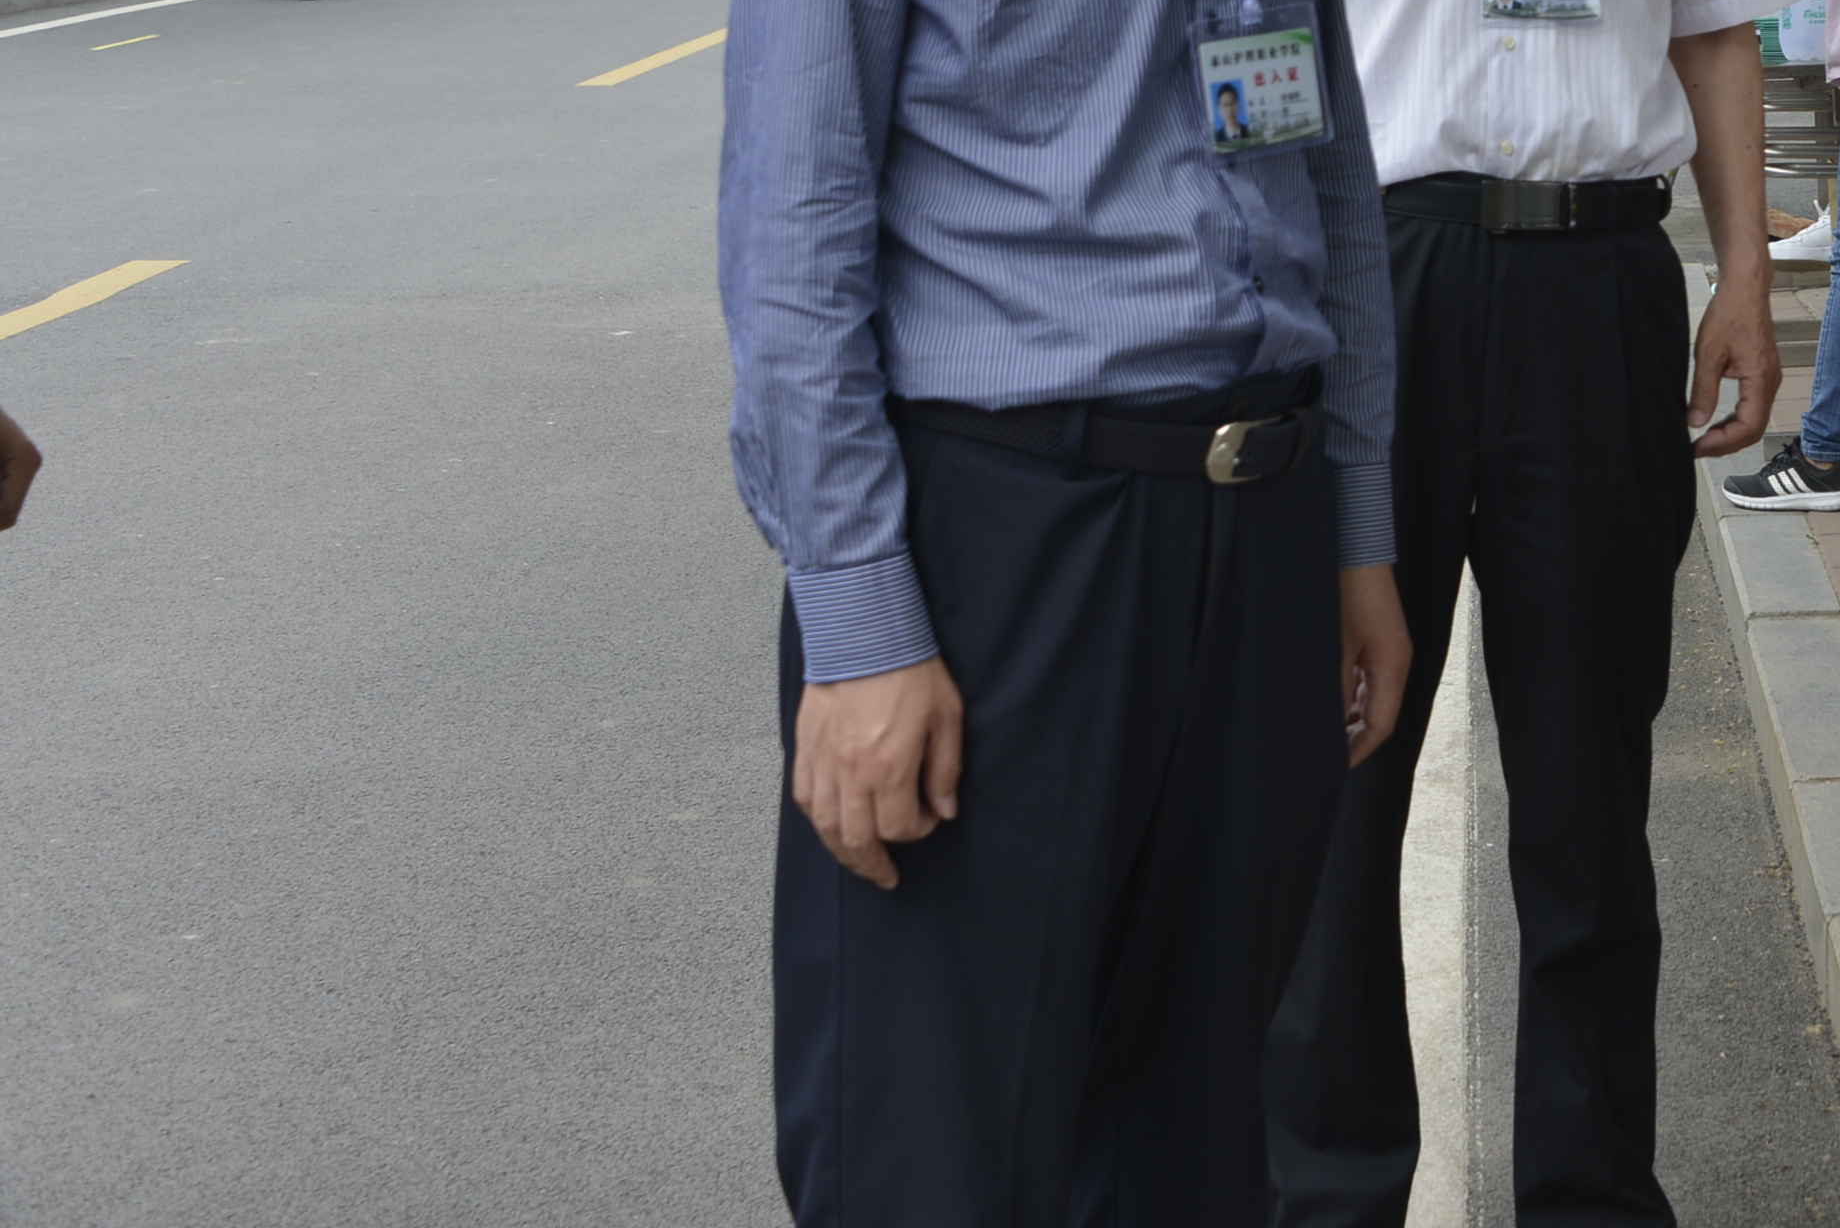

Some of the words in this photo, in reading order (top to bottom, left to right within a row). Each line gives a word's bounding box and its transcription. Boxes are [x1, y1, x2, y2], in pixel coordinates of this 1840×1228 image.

[1211, 43, 1302, 67] 泰山护理职业学院
[1254, 66, 1300, 87] 出入证
